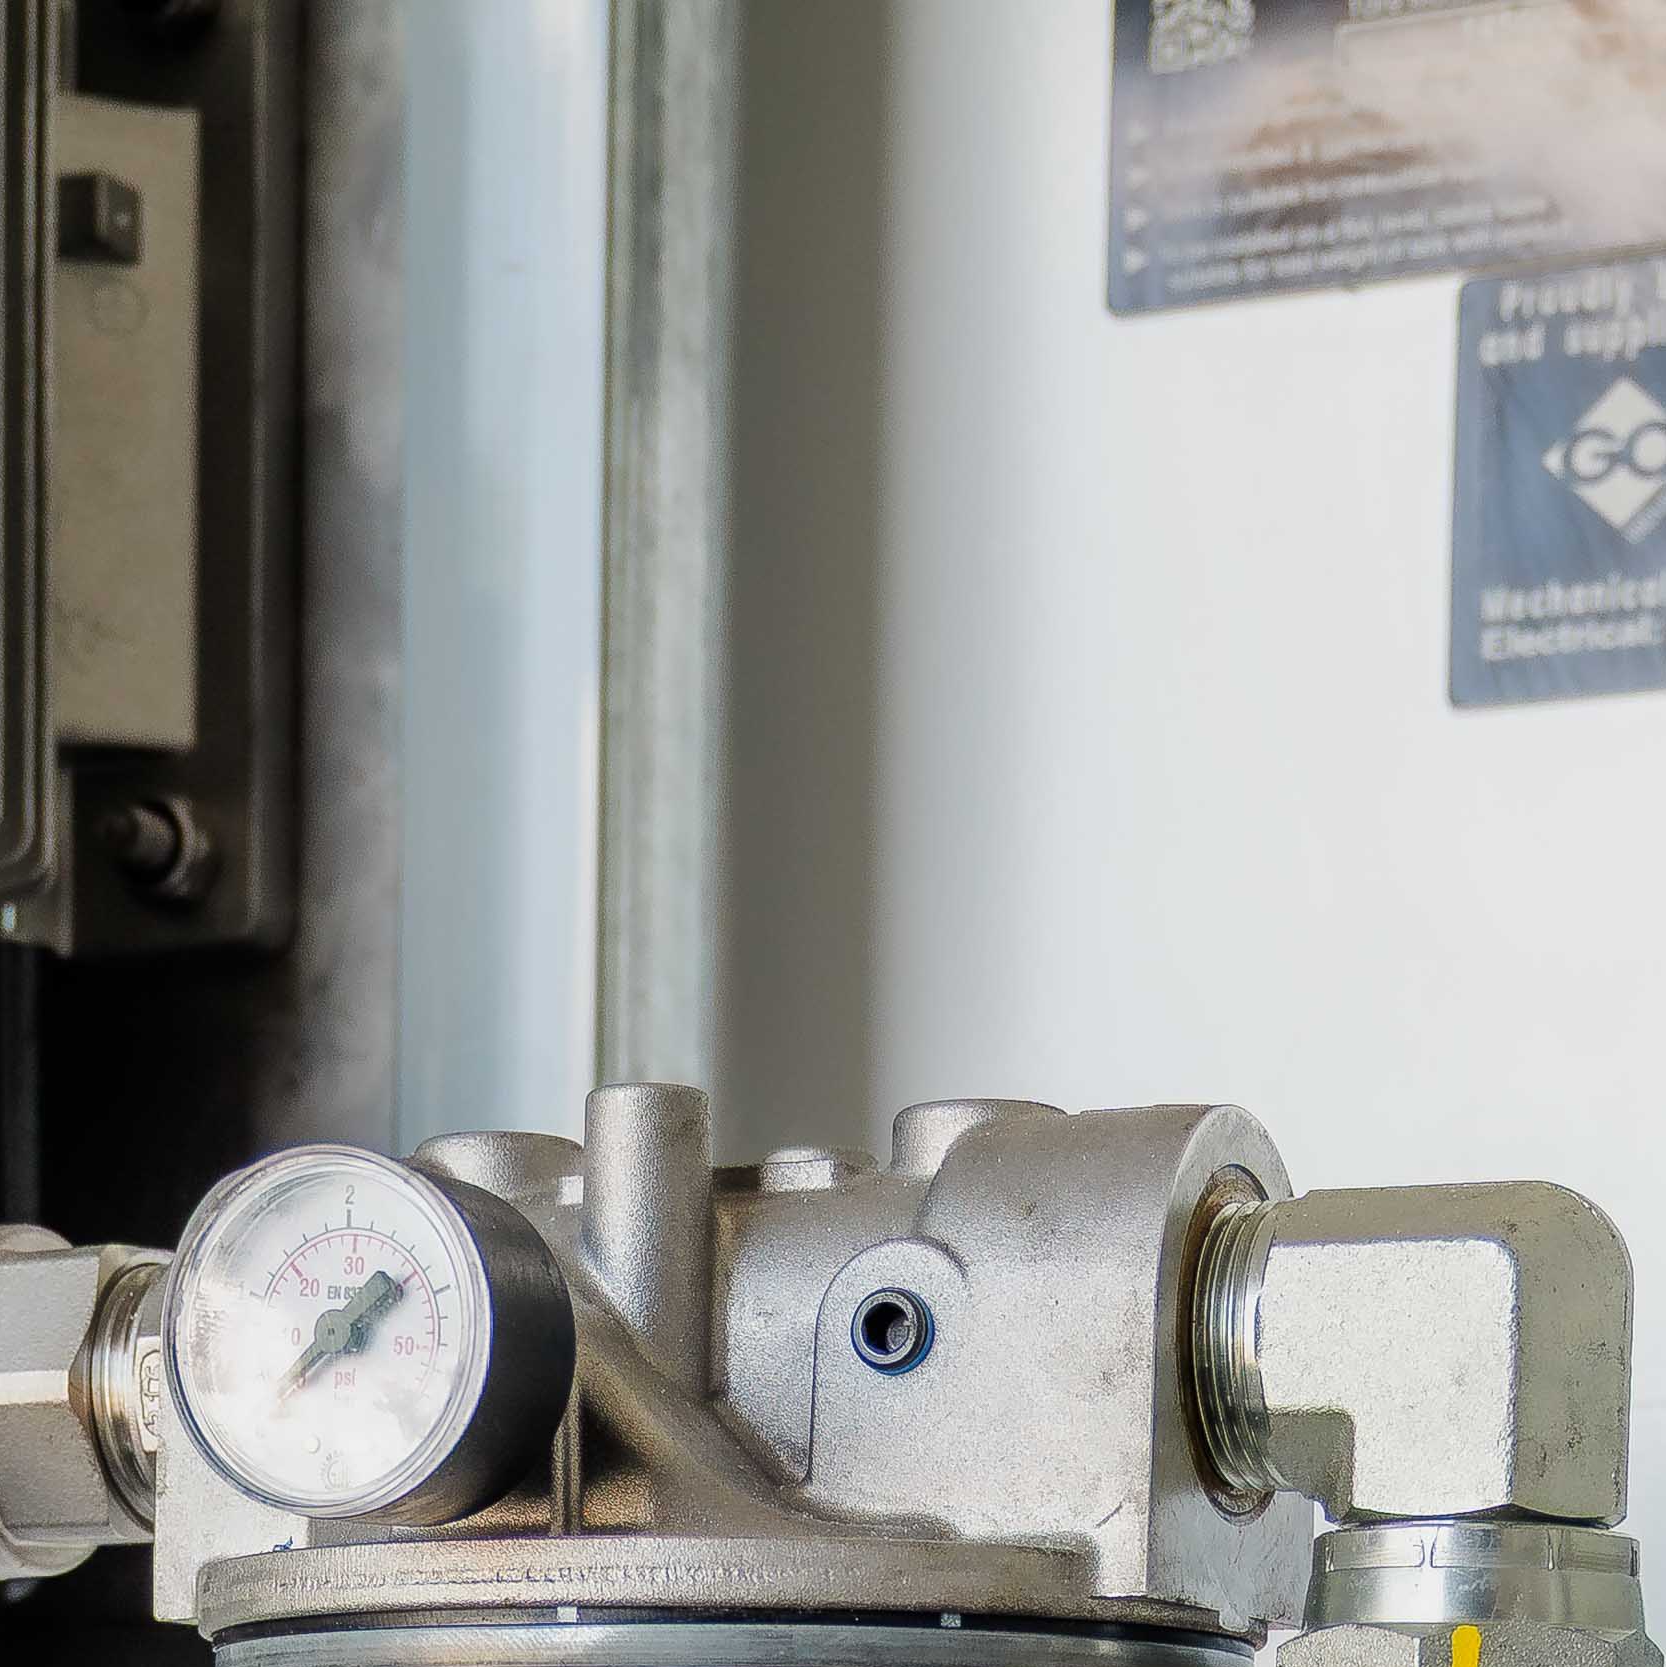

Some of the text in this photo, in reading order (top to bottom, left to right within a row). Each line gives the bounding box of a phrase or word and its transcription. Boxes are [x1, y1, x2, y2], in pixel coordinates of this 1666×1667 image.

[344, 1184, 355, 1205] 2
[343, 1256, 365, 1276] 30
[299, 1278, 320, 1298] 20
[327, 1285, 342, 1300] EN
[393, 1335, 414, 1356] 50
